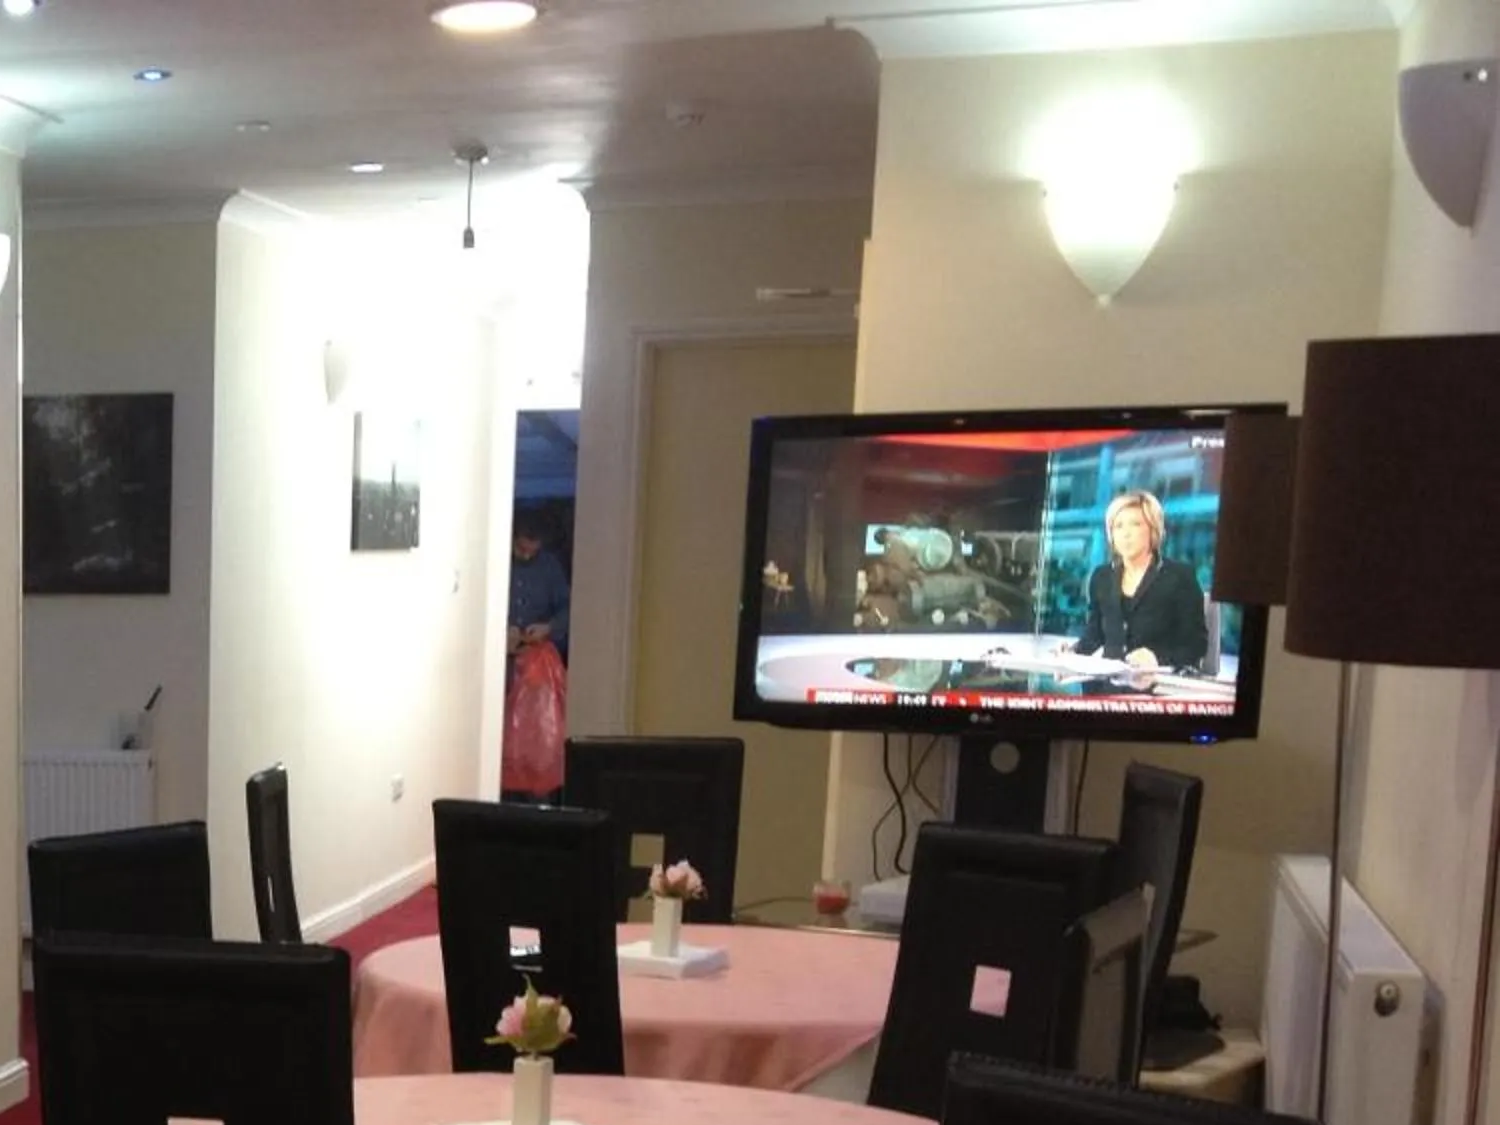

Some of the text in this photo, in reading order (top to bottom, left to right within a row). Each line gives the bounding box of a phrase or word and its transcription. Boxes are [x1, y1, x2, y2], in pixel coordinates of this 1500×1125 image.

[980, 695, 1005, 709] THE
[1047, 698, 1165, 714] ADMINISTRATORS
[1166, 703, 1185, 715] OF
